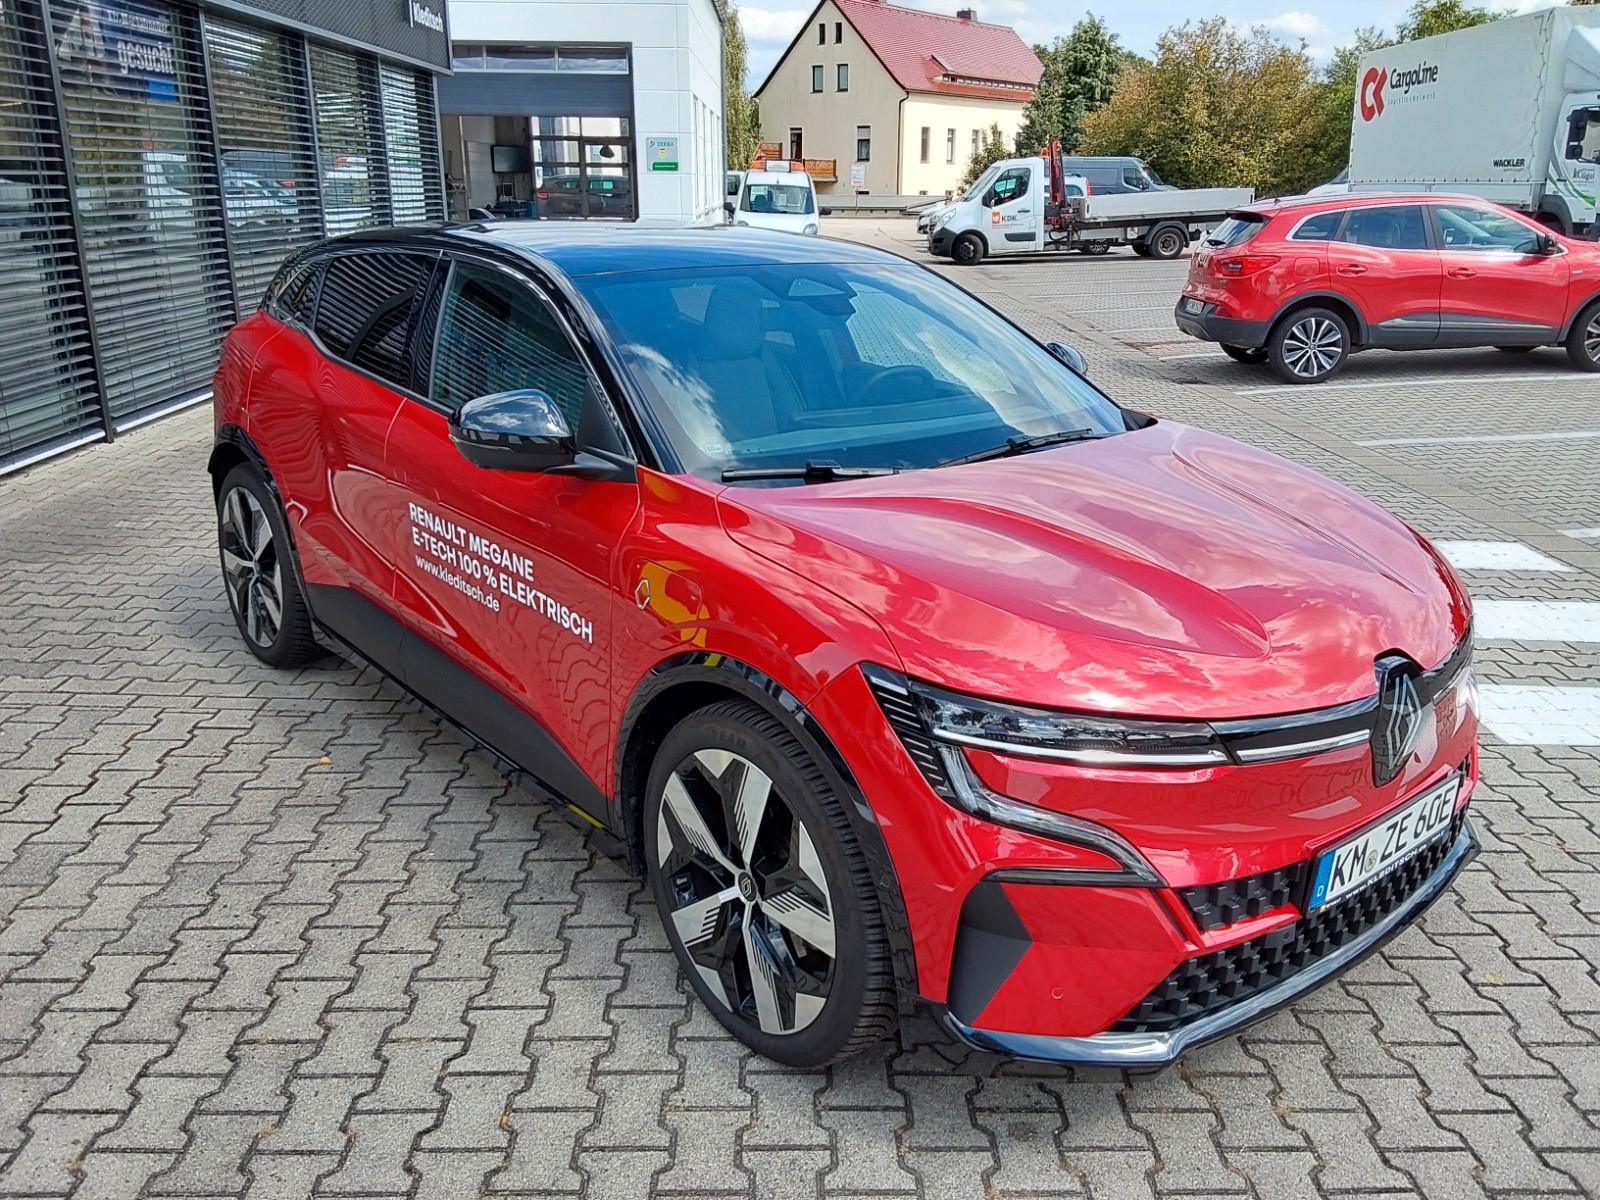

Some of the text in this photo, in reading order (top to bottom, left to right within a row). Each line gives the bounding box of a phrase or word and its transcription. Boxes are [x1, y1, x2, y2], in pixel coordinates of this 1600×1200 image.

[1390, 61, 1439, 94] CargoLine
[1492, 158, 1526, 168] WACKLER
[408, 502, 534, 581] RENAULT MEGANE
[412, 526, 457, 567] E-TECH
[457, 551, 482, 580] 100
[499, 572, 593, 644] ELEKTRISCH
[415, 553, 500, 612] www.kleditsch.de
[1316, 786, 1456, 897] D KM ZE 60E
